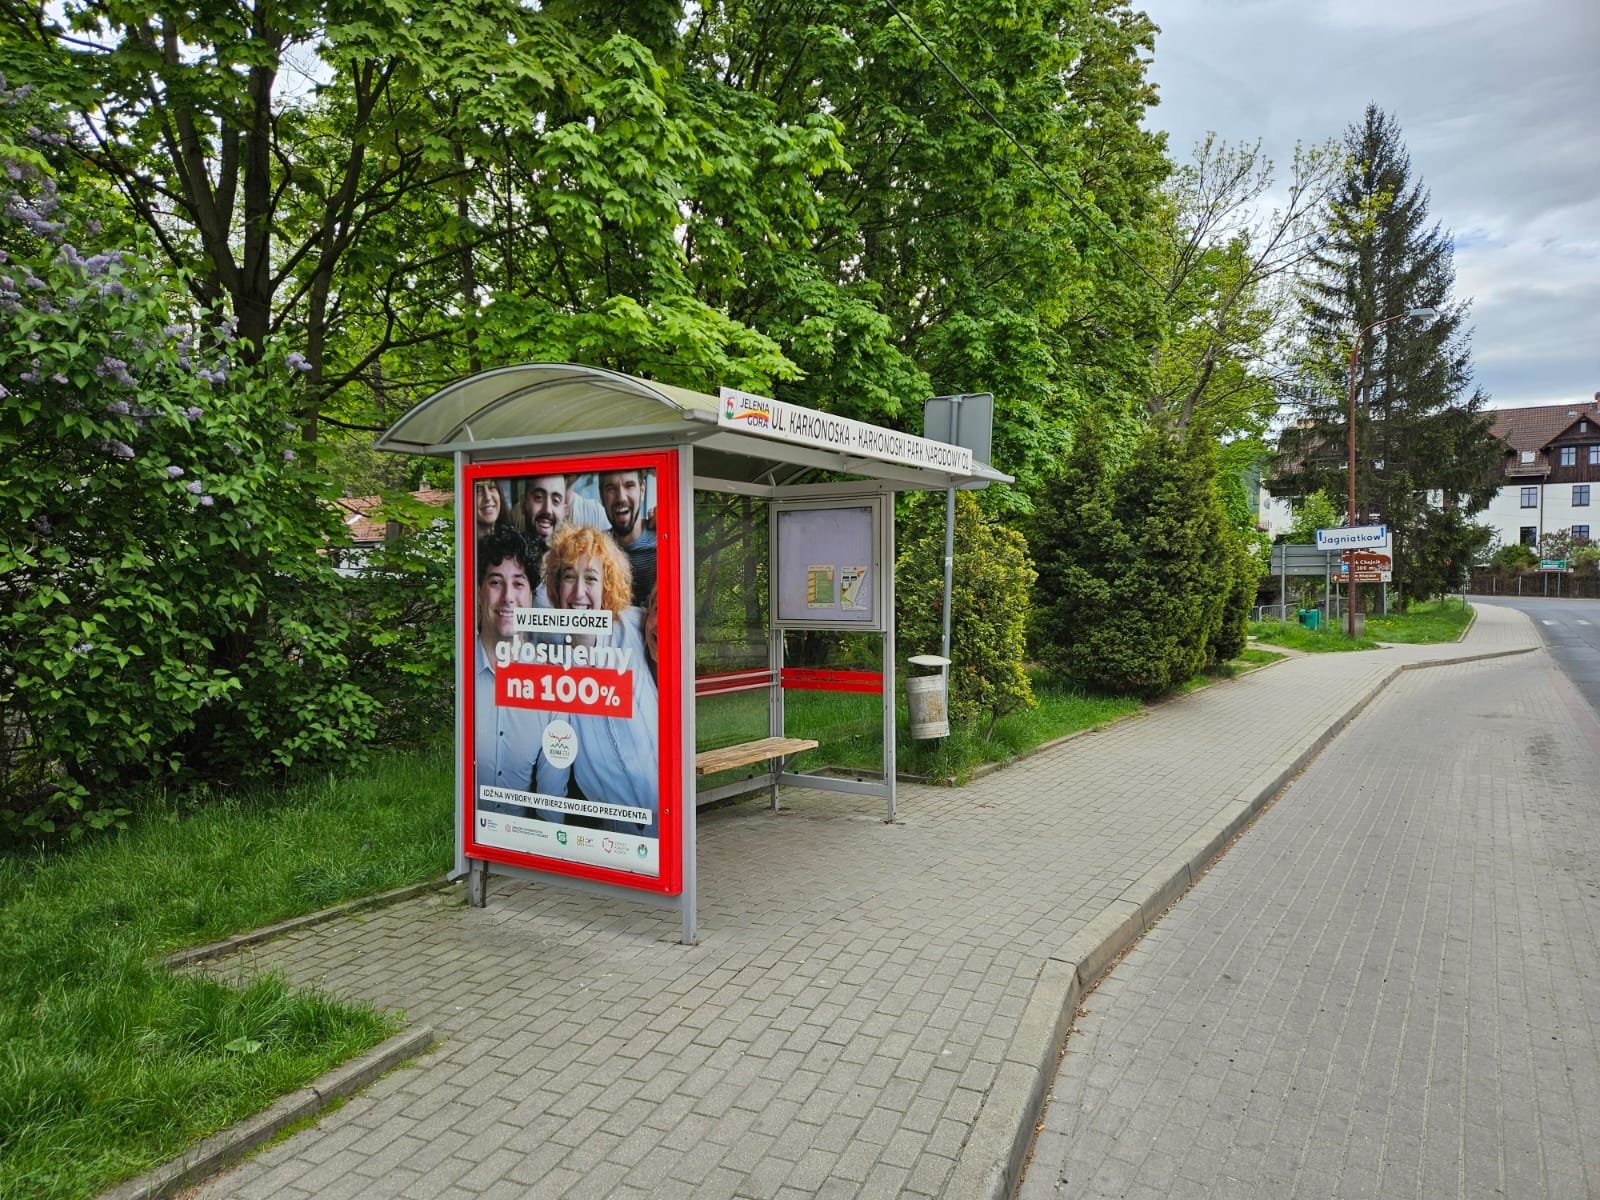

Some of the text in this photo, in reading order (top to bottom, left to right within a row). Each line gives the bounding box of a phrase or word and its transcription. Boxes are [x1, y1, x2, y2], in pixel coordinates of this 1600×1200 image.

[740, 397, 770, 413] JELENIA
[771, 407, 786, 431] UL.
[789, 411, 850, 446] KARKONOSKA
[858, 427, 906, 457] KARKONOSKI
[907, 440, 924, 462] PARK
[925, 444, 961, 468] NARODOWY
[516, 613, 609, 629] W JELENIEJ GÓRZE
[495, 634, 632, 677] głosujemy
[506, 674, 621, 707] na 100%
[494, 790, 504, 800] NA
[504, 791, 533, 805] WYBORY,
[533, 797, 563, 809] WYBIERZ
[563, 802, 599, 814] SWOJEGO
[599, 806, 648, 821] PREZYDENTA
